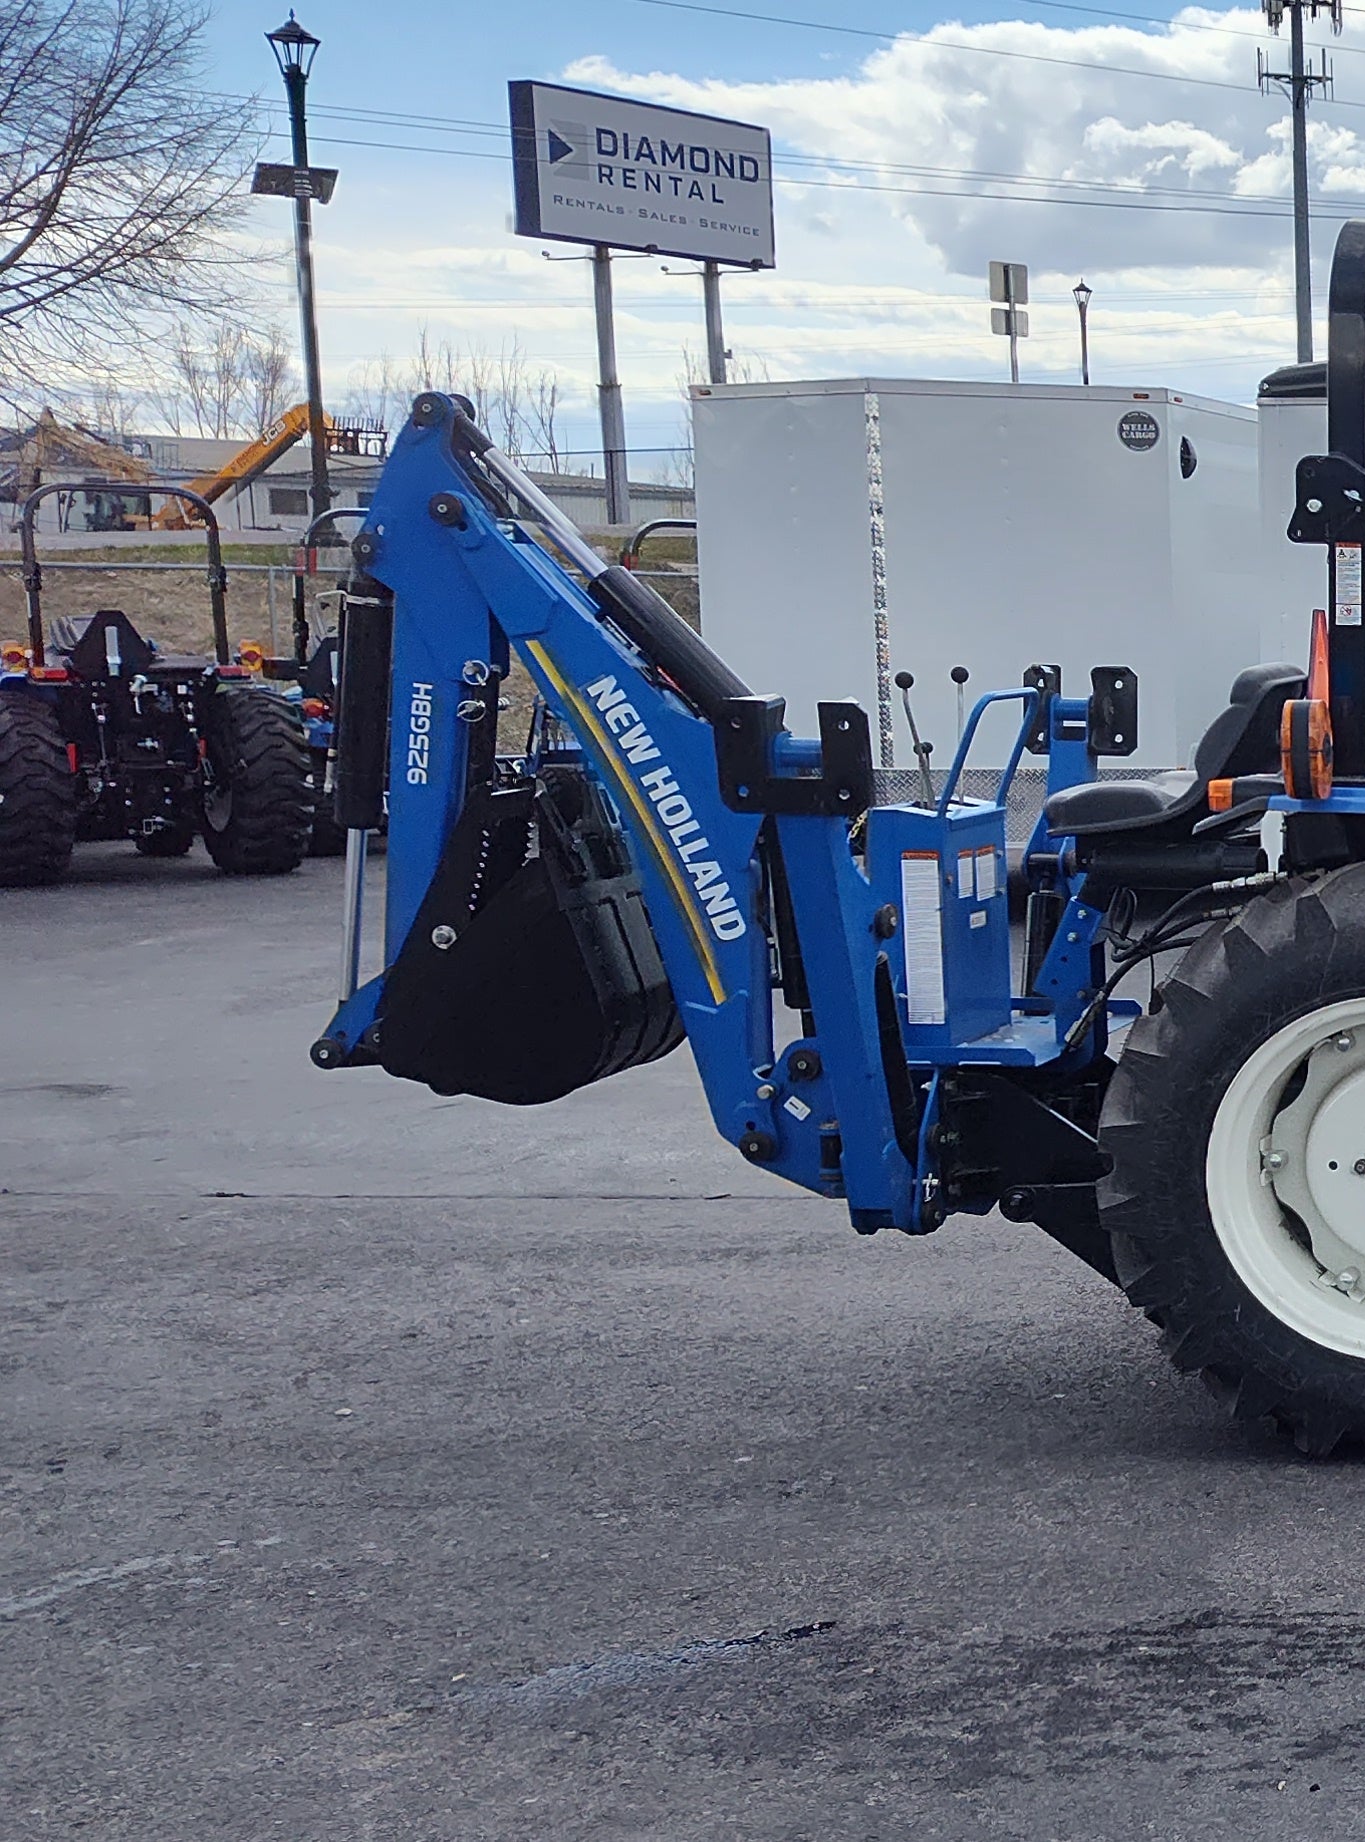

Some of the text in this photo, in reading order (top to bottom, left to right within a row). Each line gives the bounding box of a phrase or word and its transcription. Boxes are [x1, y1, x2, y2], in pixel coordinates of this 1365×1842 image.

[595, 127, 759, 183] DIAMOND
[598, 163, 725, 204] RENTAL
[262, 418, 286, 446] JCB
[1121, 423, 1156, 431] WELLS
[1121, 431, 1156, 439] CARGO
[407, 682, 433, 785] 925GBH
[586, 674, 747, 941] NEW HOLLAND
